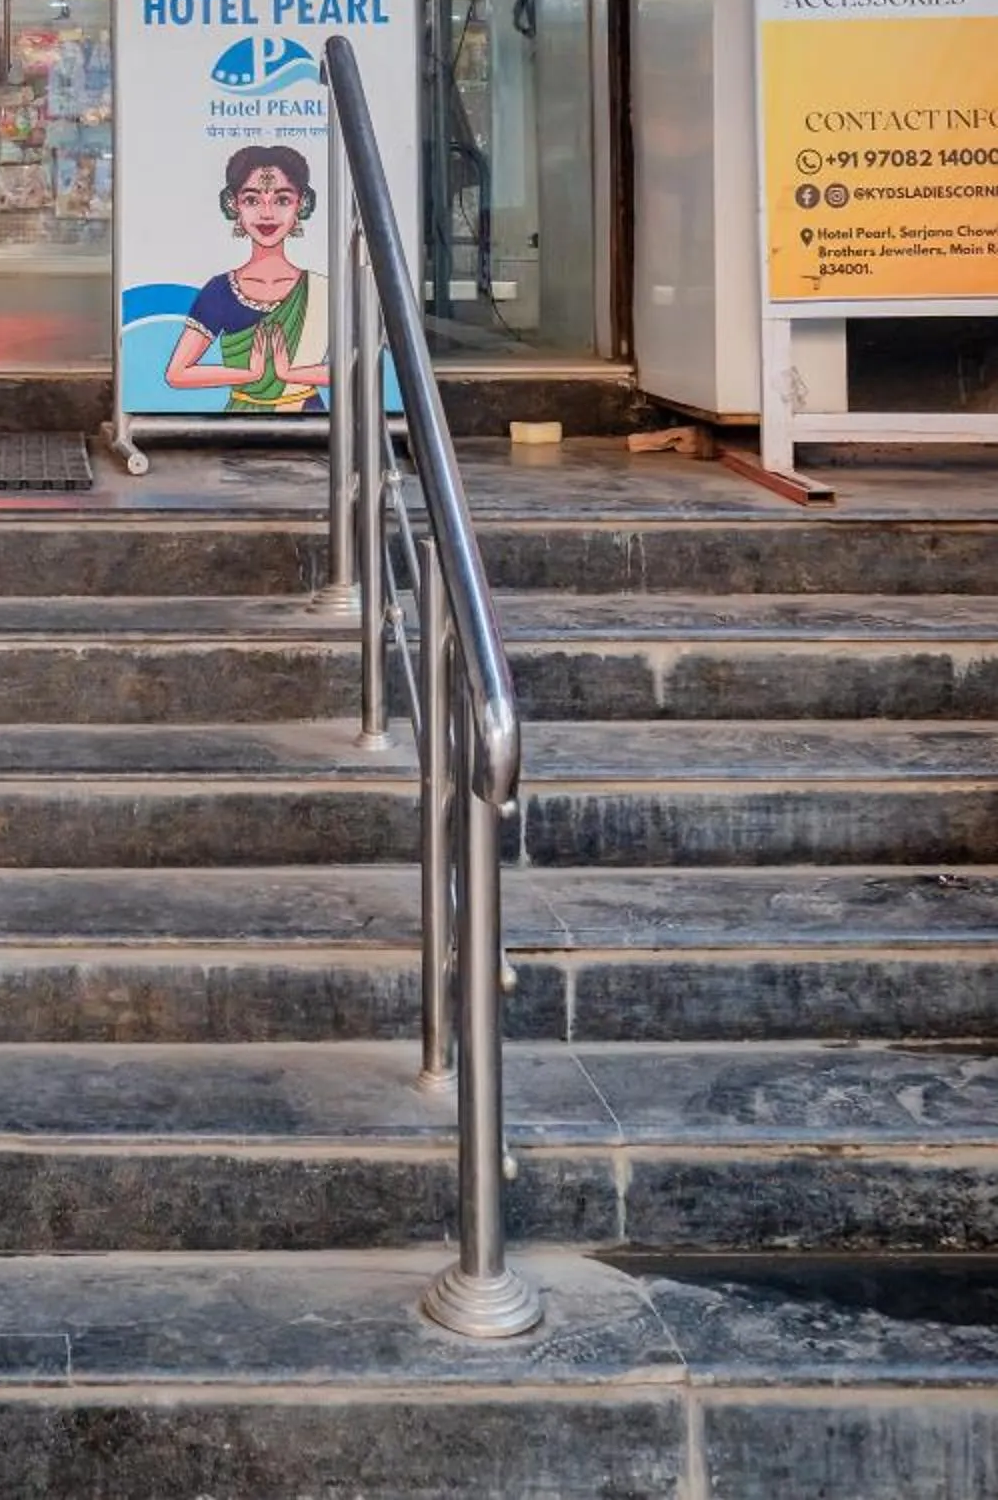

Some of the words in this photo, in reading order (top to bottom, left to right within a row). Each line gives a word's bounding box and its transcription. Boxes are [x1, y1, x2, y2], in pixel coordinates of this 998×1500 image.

[211, 100, 261, 116] Hotel
[267, 100, 327, 116] PEARL
[805, 110, 940, 132] CONTACT
[825, 151, 858, 168] +91
[864, 150, 932, 167] 97082
[938, 148, 998, 166] 14000
[817, 227, 852, 239] Hotel
[900, 225, 953, 240] Sarjana
[957, 225, 998, 238] Chow
[818, 245, 875, 258] Brothers
[879, 243, 946, 257] Jewellers,
[950, 243, 984, 255] Main
[819, 263, 873, 276] 834001.
